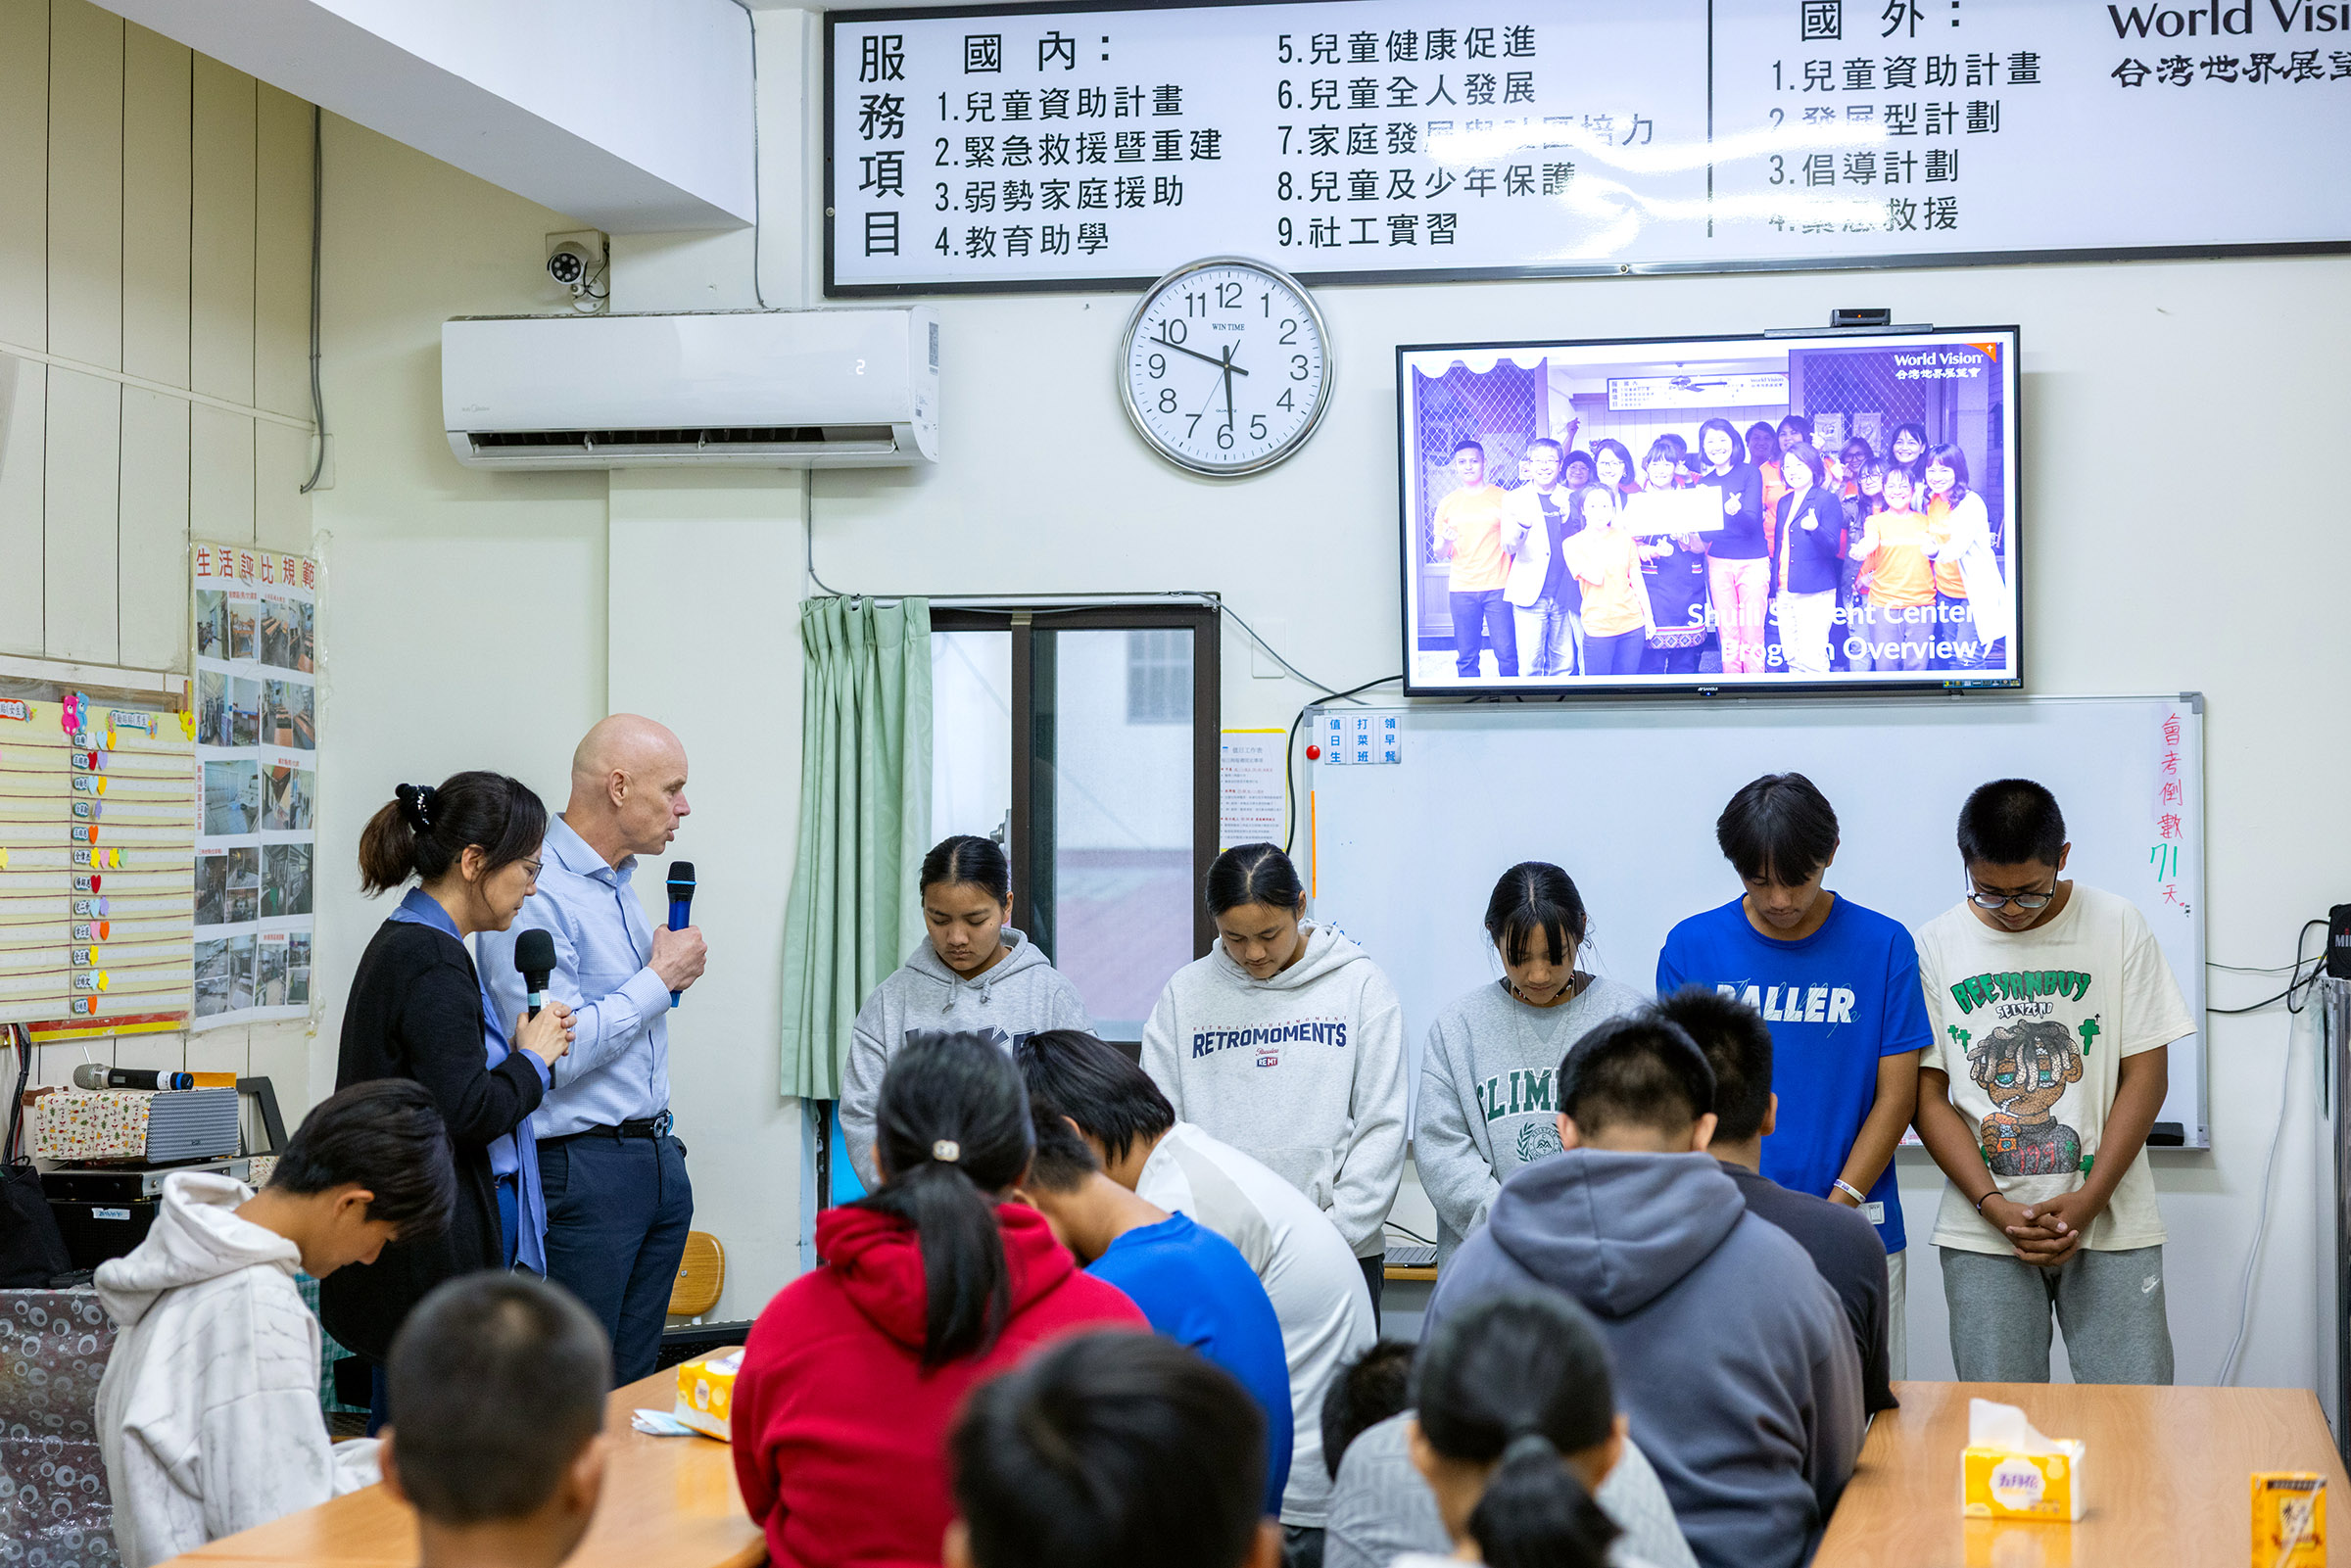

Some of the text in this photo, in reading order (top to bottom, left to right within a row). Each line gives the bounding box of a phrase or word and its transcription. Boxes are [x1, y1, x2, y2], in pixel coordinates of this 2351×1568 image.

[2107, 0, 2253, 39] World
[1277, 24, 1537, 65] 5.兒童健康促進
[1277, 71, 1536, 111] 6.兒童全人發展
[1771, 51, 2041, 94] 1.兒童資助計畫
[937, 83, 1184, 123] 1.兒童資助計畫
[858, 33, 906, 258] 服務項目
[935, 128, 1223, 168] 2.緊急救援暨重建
[1277, 162, 1575, 203] 8.兒童及少年保護
[1768, 148, 1959, 187] 3.倡導計劃
[935, 175, 1184, 214] 3.弱勢家庭援助
[935, 222, 1110, 259] 4.教育助學
[1277, 212, 1458, 249] 9.社工實習
[1185, 293, 1207, 318] 11
[1216, 282, 1243, 309] 12
[1261, 293, 1270, 318] 1
[1159, 319, 1187, 345] 10
[1278, 319, 1298, 346] 2
[1148, 354, 1166, 379] 9
[1289, 355, 1310, 381] 3
[1895, 352, 1982, 366] World Vision
[1158, 388, 1177, 414] 8
[1276, 387, 1295, 412] 4
[1185, 413, 1203, 439] 7
[1217, 424, 1234, 450] 6
[1249, 414, 1268, 440] 5
[1687, 601, 1760, 627] Shuili
[1768, 601, 1875, 626] Sent
[1843, 635, 1978, 661] Overview
[1330, 718, 1341, 763] 值日生
[1357, 718, 1369, 763] 打菜班
[1384, 718, 1397, 763] 領早餐
[1192, 1022, 1348, 1059] RETROMOMENTS
